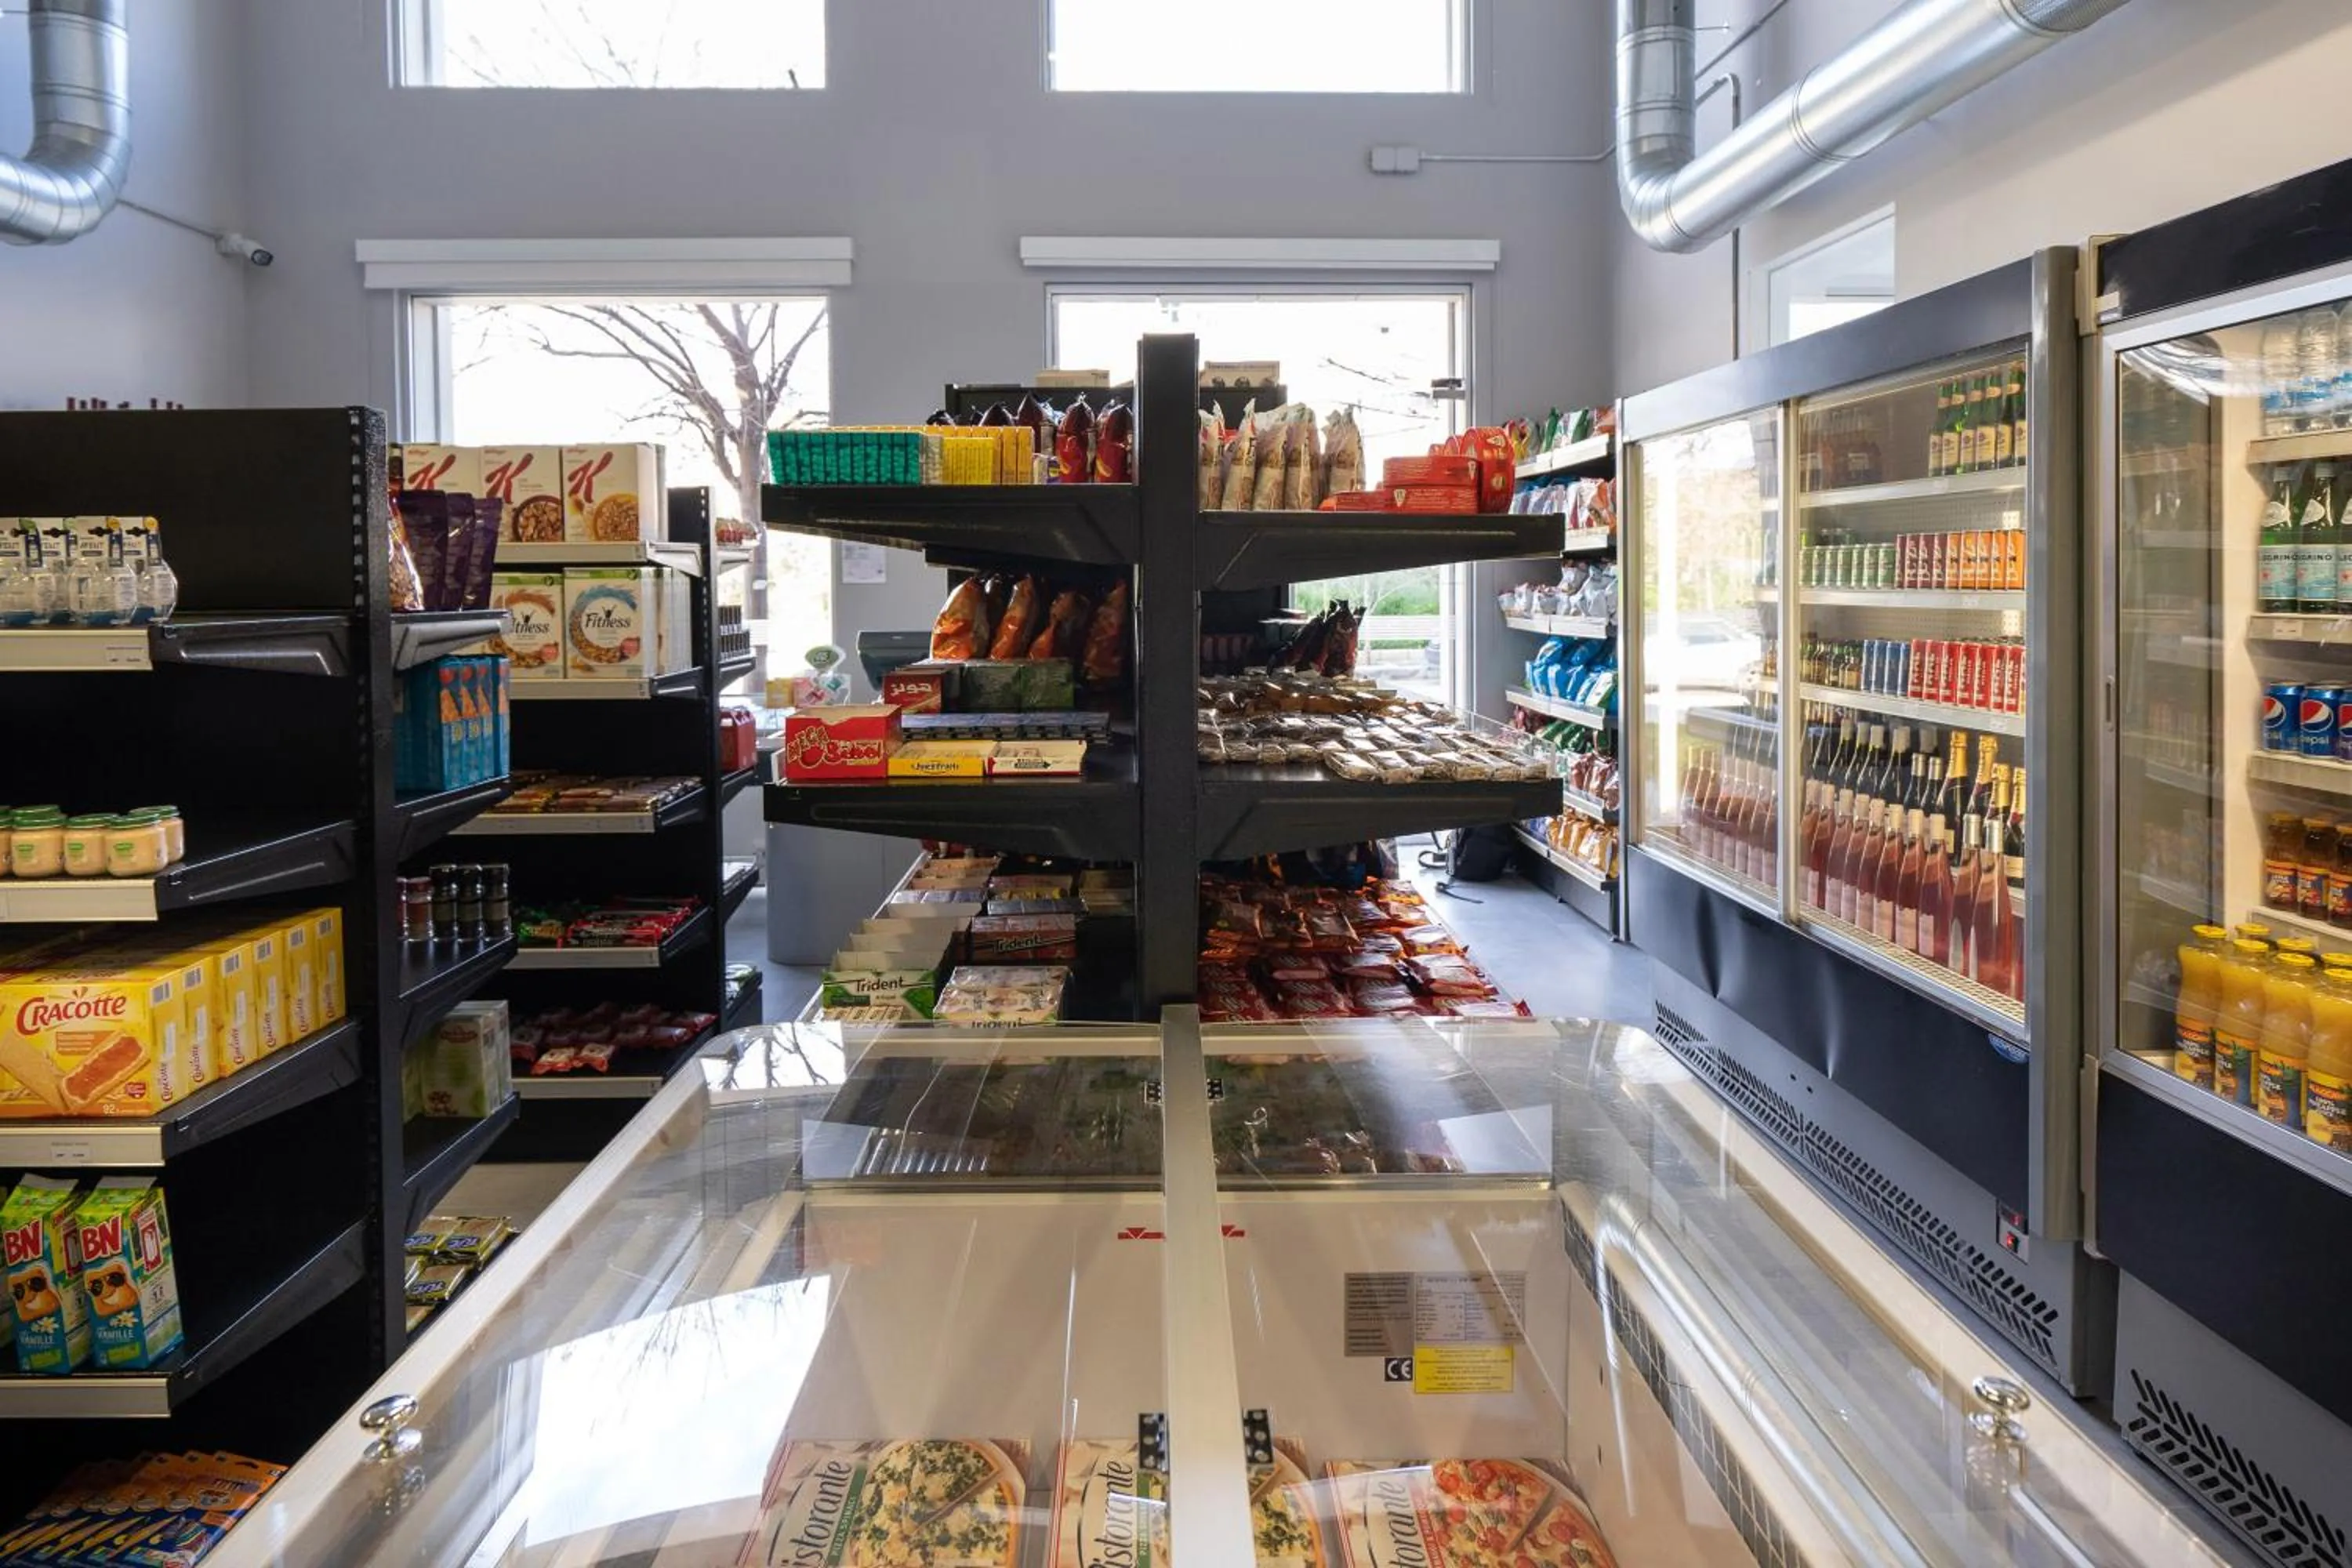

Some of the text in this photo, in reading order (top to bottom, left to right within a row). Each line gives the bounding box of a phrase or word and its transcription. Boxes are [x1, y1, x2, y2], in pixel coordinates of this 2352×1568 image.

[568, 451, 614, 503] K
[513, 618, 550, 634] tness
[586, 611, 632, 629] Fitness
[855, 975, 905, 993] Trident
[4, 1219, 42, 1265] BN
[82, 1214, 122, 1262] BN
[781, 1461, 853, 1568] istorante
[1089, 1461, 1134, 1568] istorante
